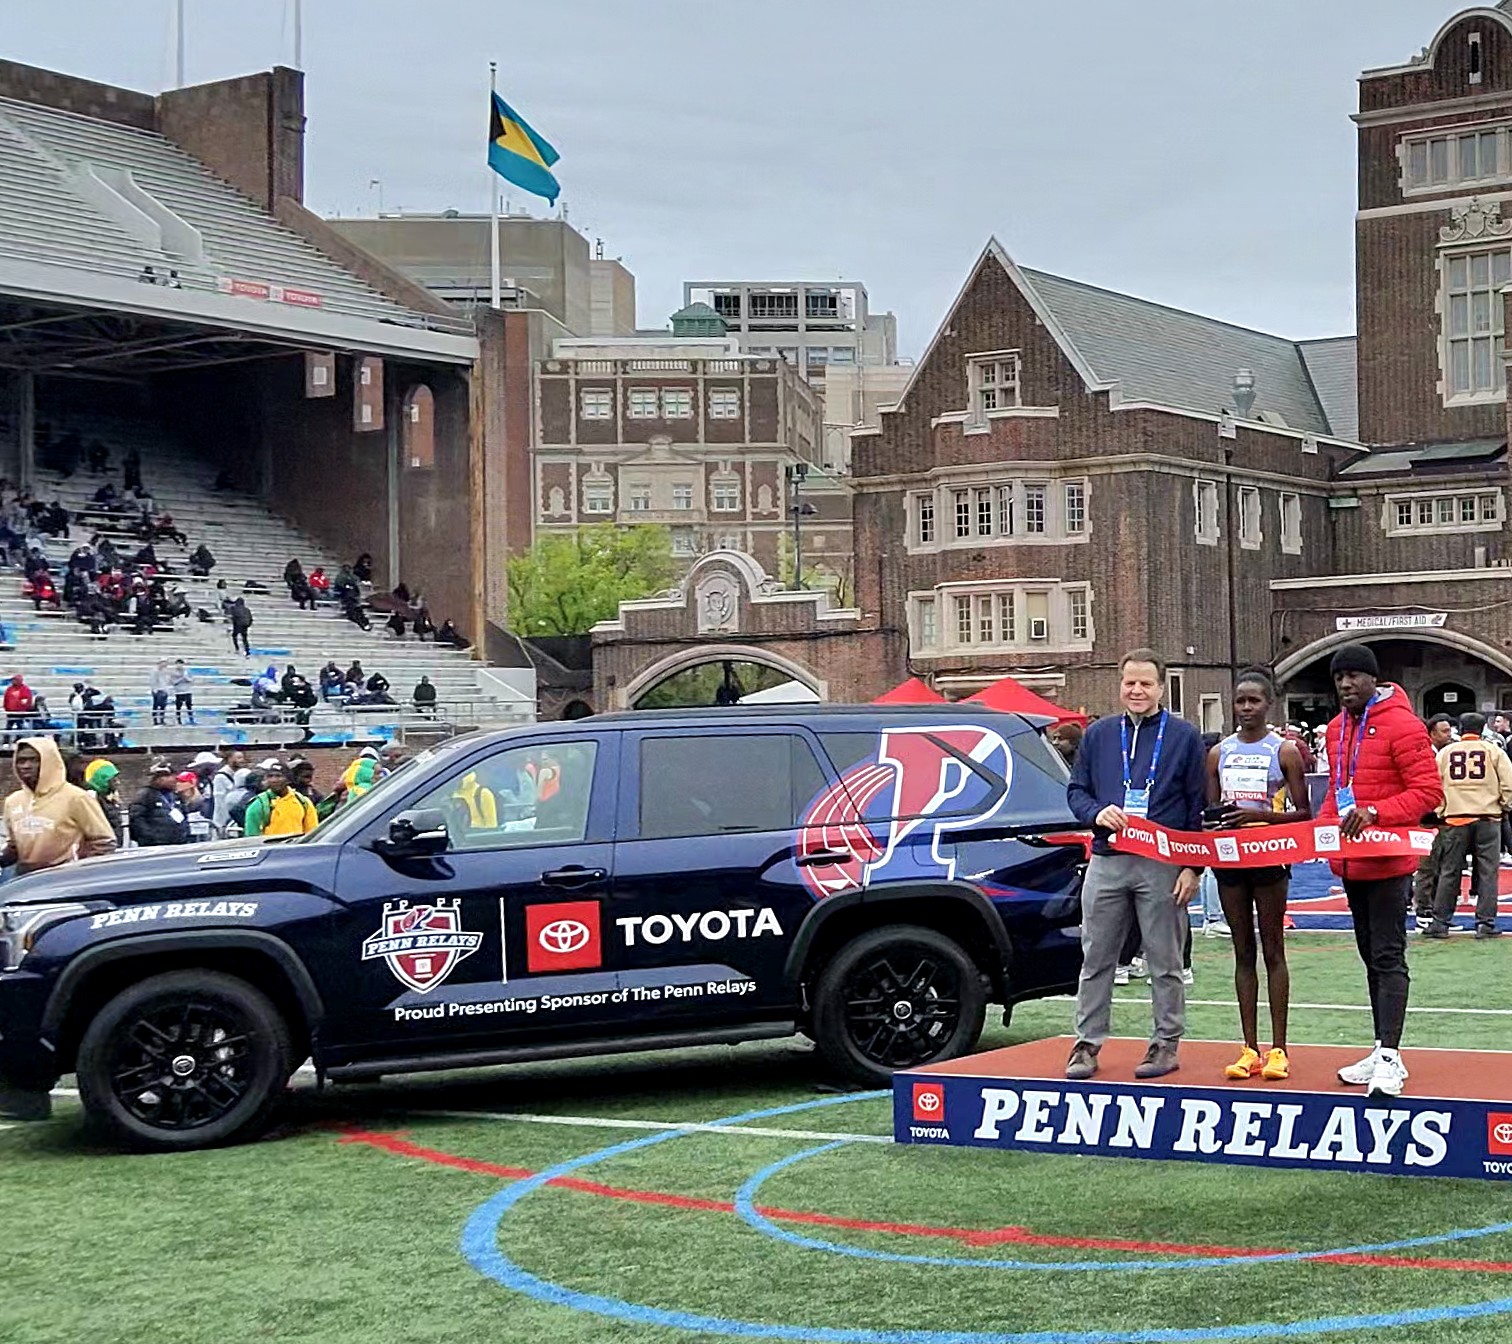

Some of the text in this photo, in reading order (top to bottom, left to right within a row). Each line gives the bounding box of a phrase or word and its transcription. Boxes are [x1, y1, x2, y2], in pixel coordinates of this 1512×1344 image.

[1414, 615, 1427, 625] AID
[1449, 750, 1486, 780] 83
[1235, 792, 1263, 800] TOYOTA
[1122, 826, 1402, 856] TOYOTA TOYOTA TOYOTA OYOTA
[90, 902, 259, 930] PENN RELAYS
[616, 907, 784, 947] TOYOTA
[367, 935, 478, 956] PENN RELAYS
[395, 979, 757, 1021] Proud Presenting Sponsor of The Penn Relays
[909, 1126, 950, 1140] TOYOTA
[973, 1087, 1452, 1167] PENN RELAYS
